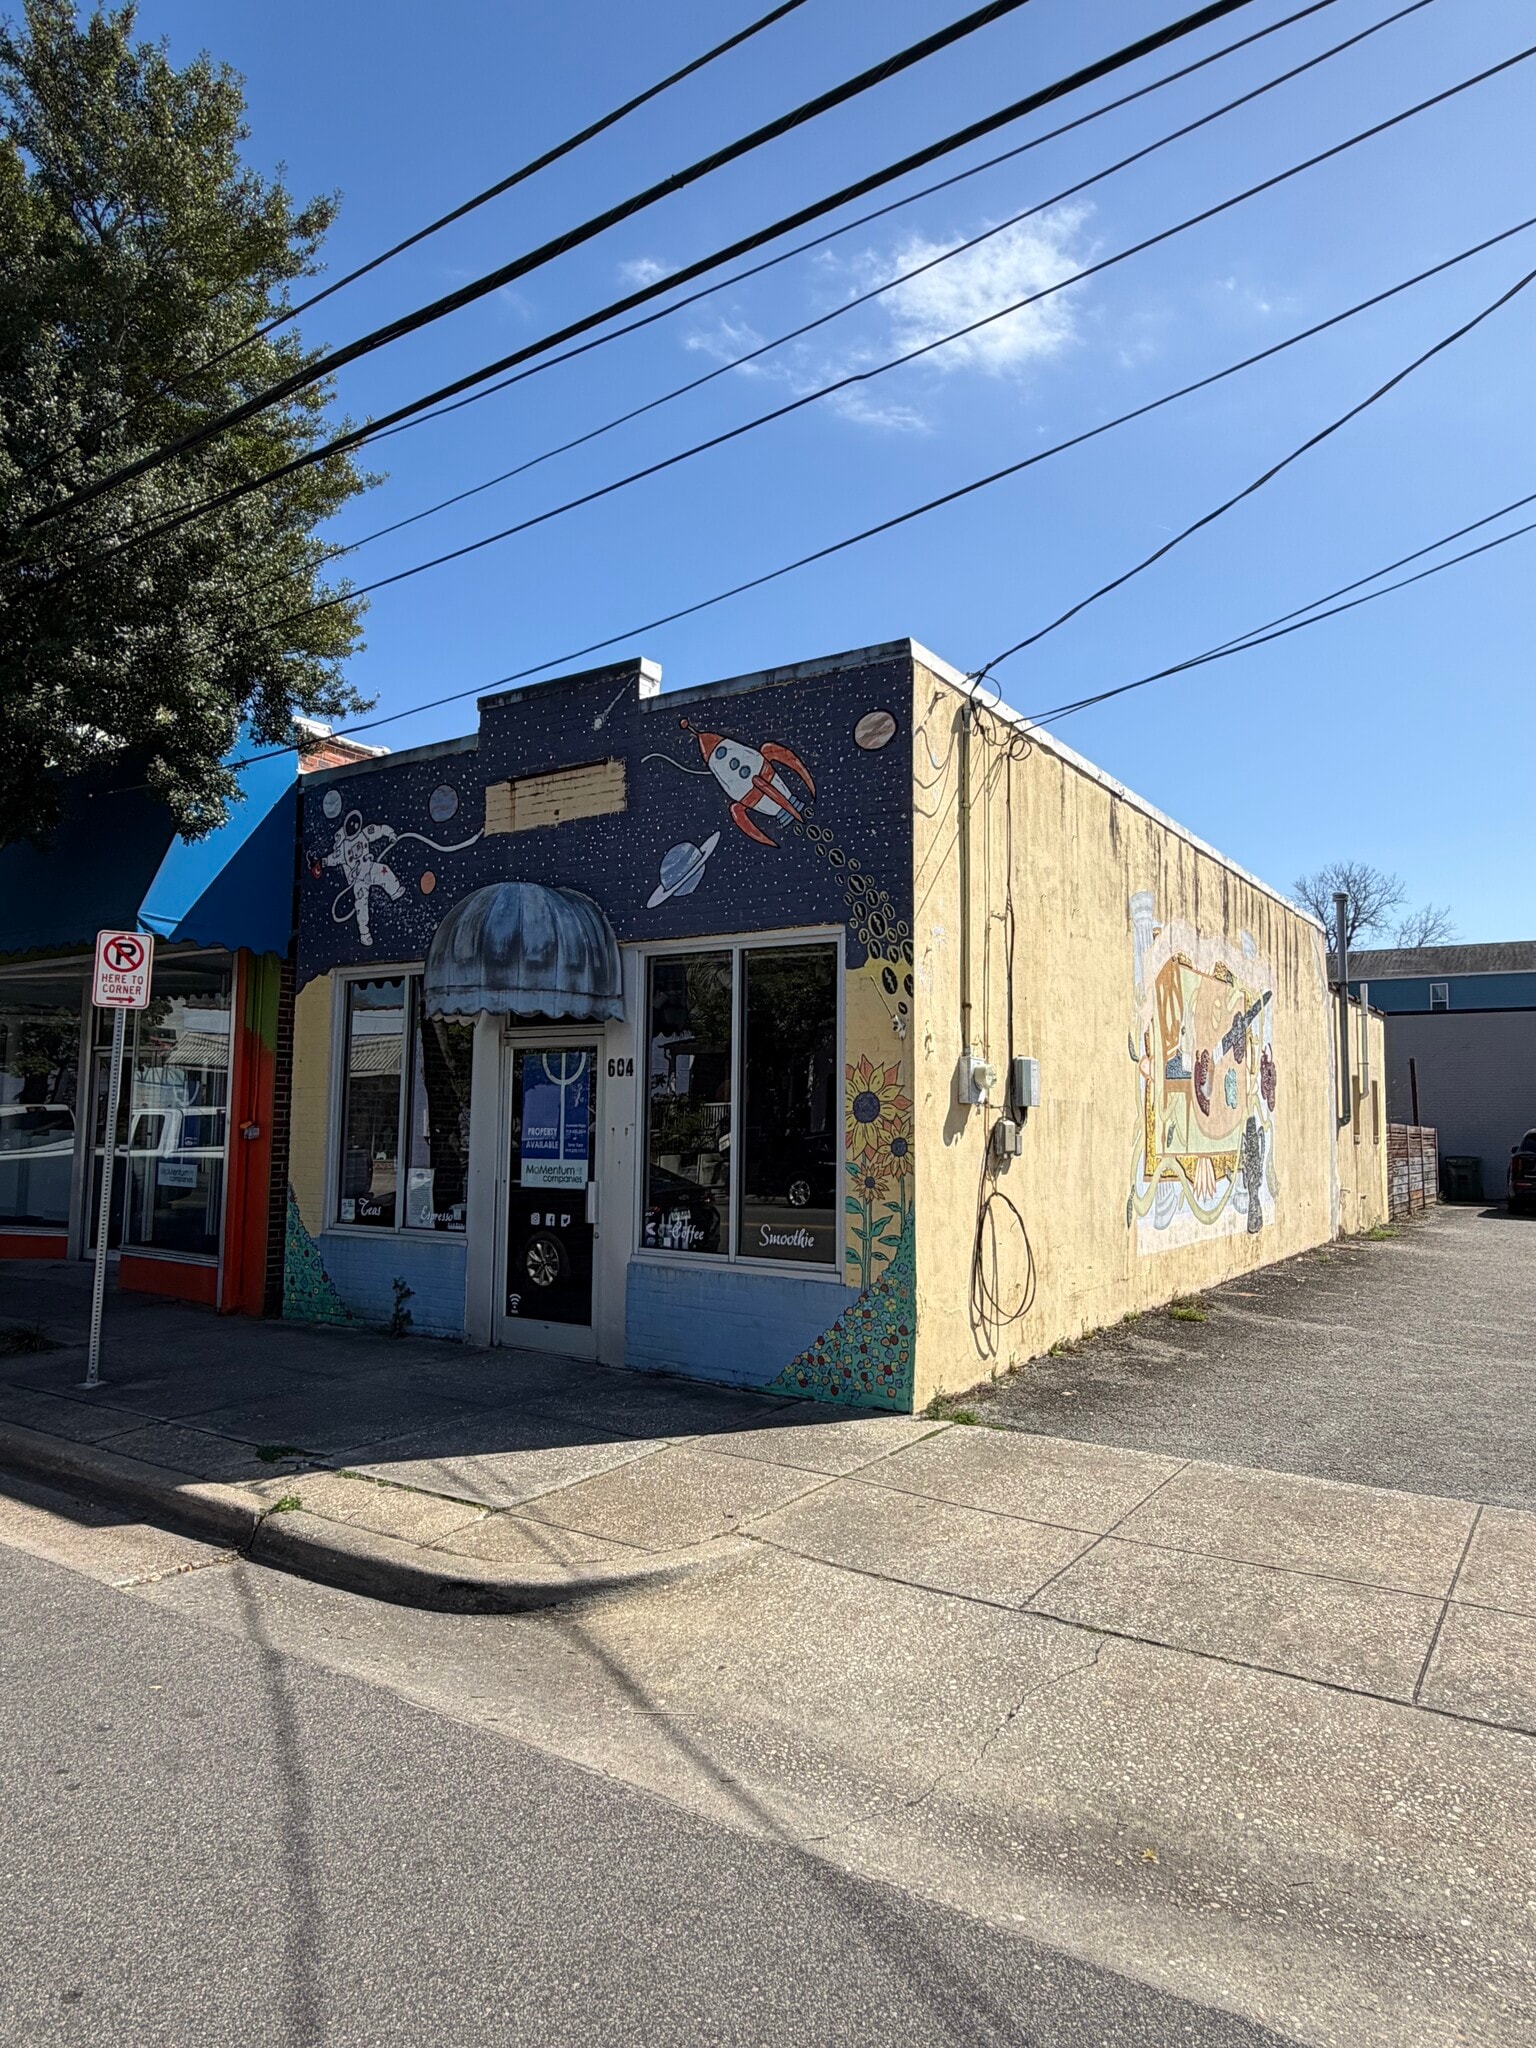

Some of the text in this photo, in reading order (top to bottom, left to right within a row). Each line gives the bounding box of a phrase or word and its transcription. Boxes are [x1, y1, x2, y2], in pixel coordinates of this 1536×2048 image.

[101, 973, 144, 985] HERE TO
[102, 983, 142, 995] CORNER
[608, 1058, 634, 1077] 604
[527, 1127, 558, 1136] PROPERTY
[525, 1140, 559, 1149] AVAILABLE
[526, 1165, 576, 1175] MoMentum
[542, 1175, 583, 1184] companies
[358, 1197, 382, 1216] Teas
[420, 1205, 454, 1224] Espresso
[670, 1221, 705, 1244] Coffee
[758, 1223, 815, 1249] Smoothie
